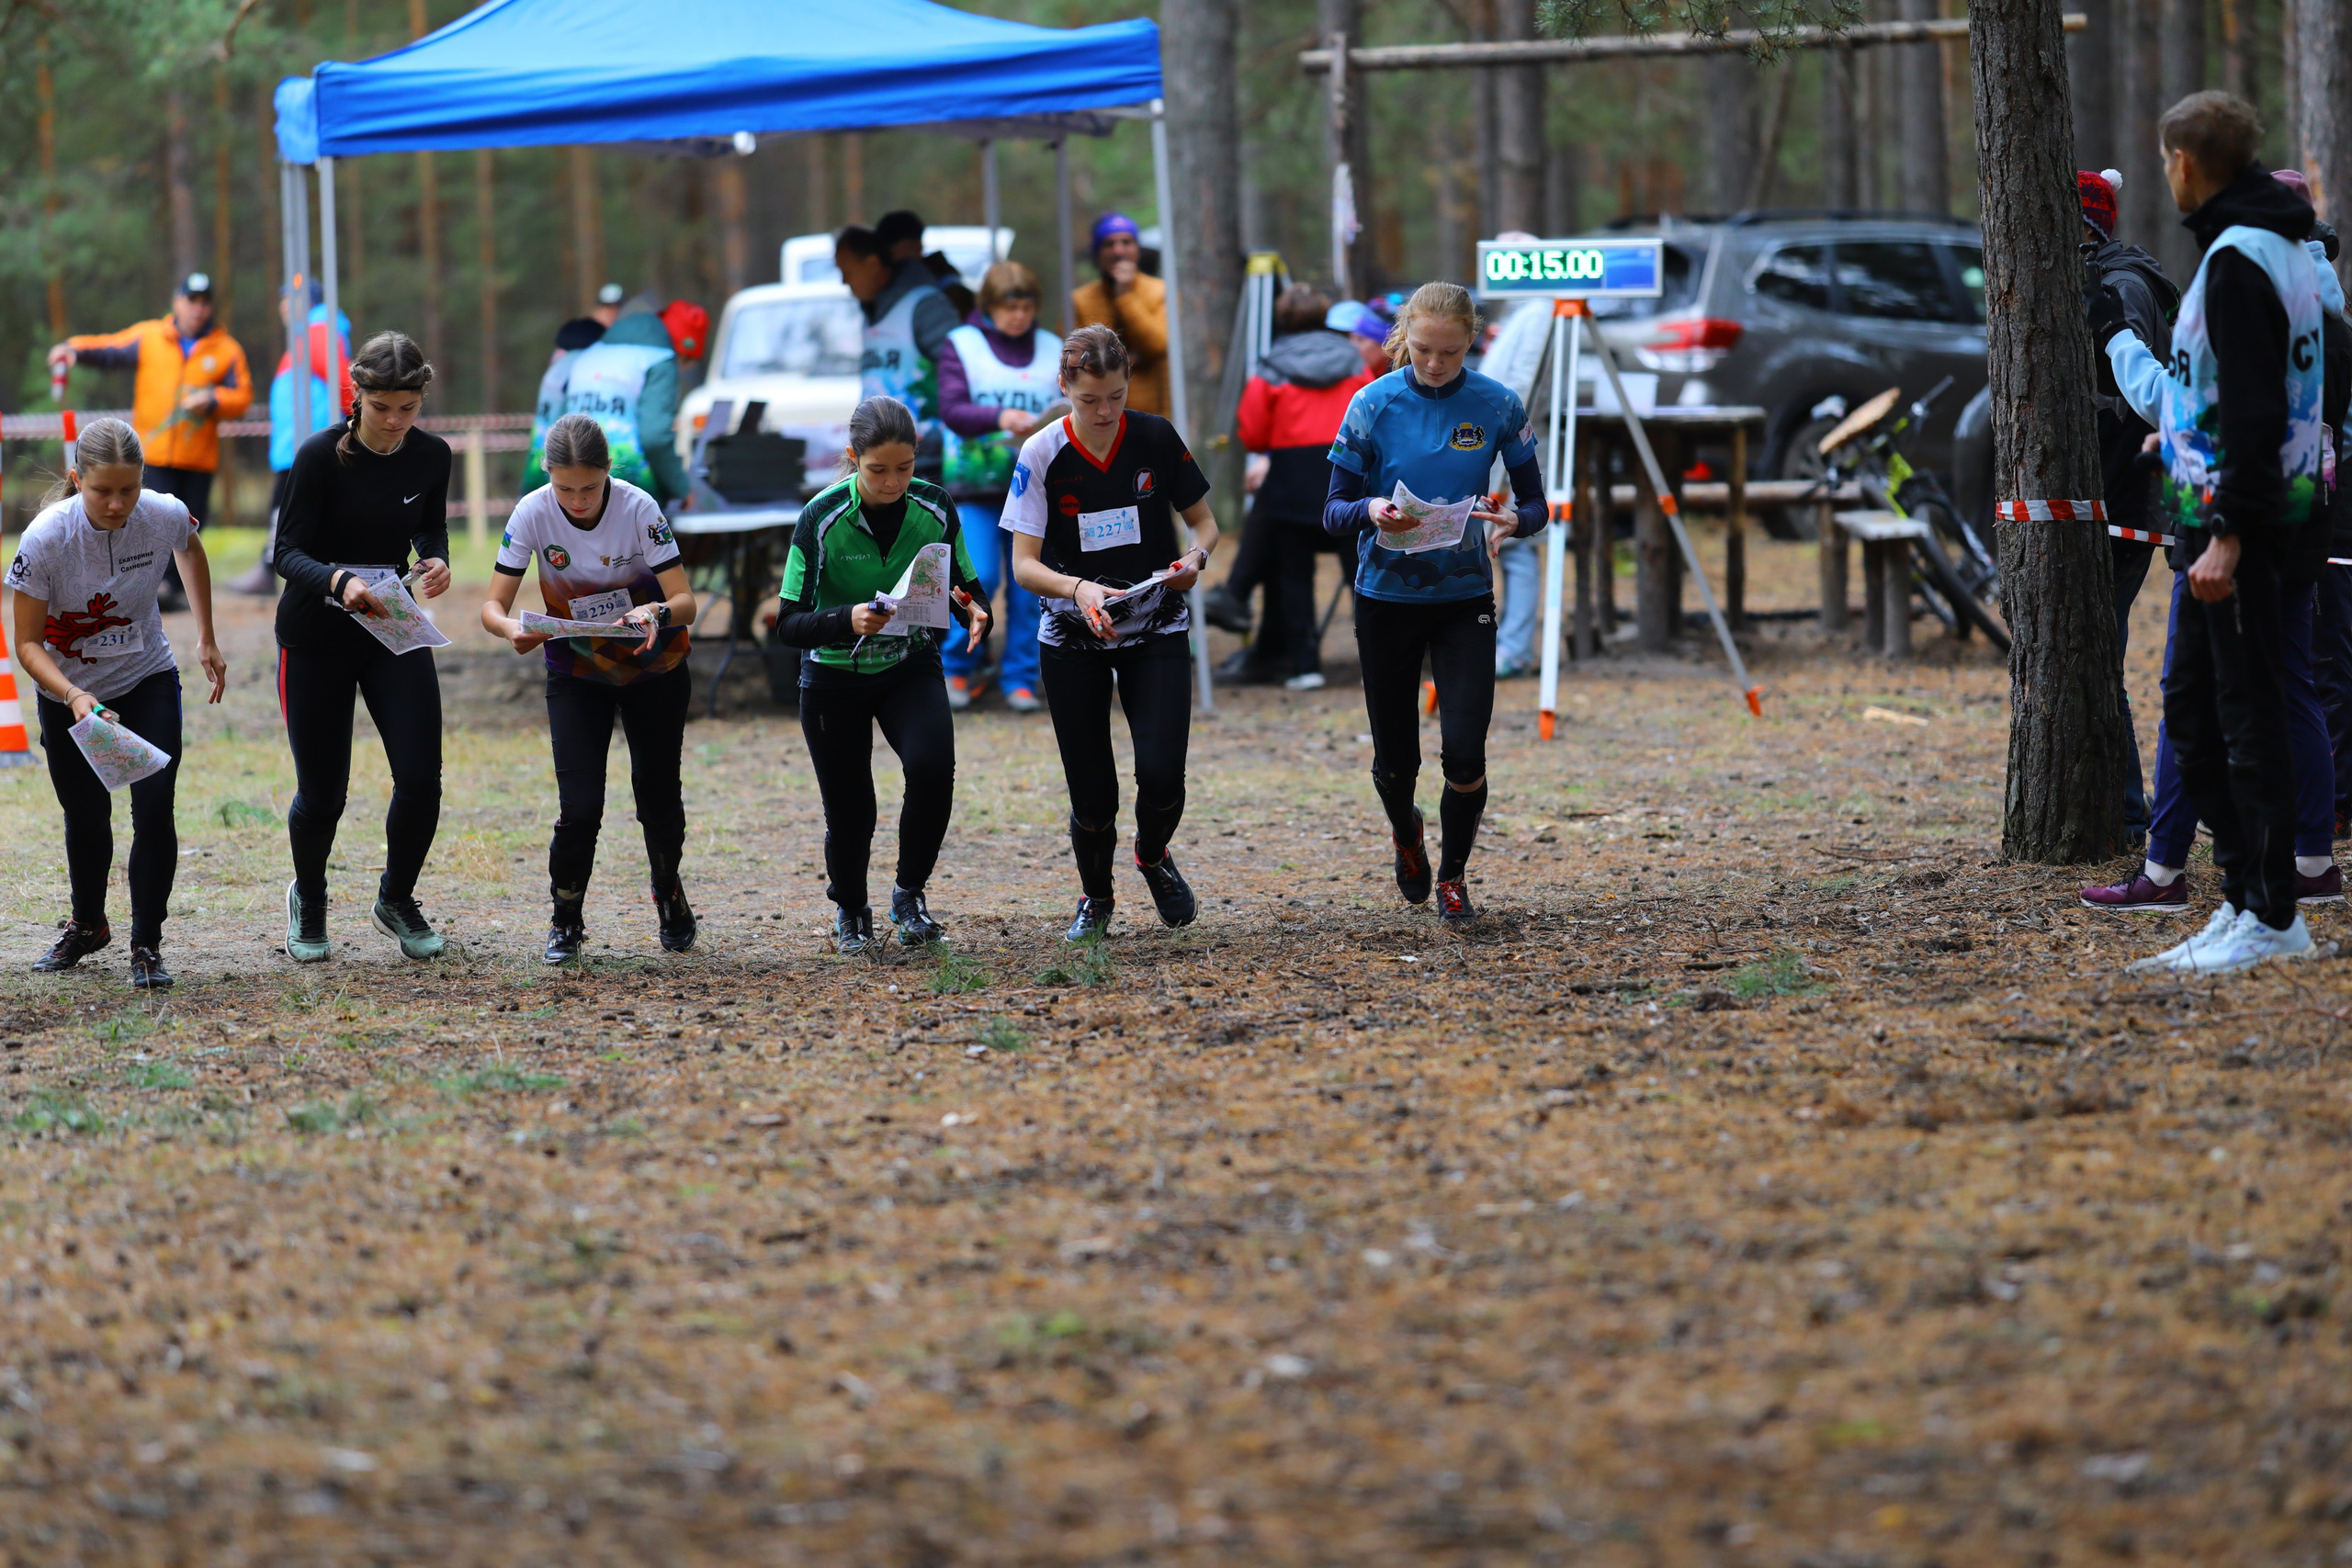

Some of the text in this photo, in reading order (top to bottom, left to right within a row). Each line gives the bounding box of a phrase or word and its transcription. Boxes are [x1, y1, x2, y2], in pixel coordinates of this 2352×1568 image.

[1486, 249, 1604, 280] 00:15.00
[1096, 522, 1122, 538] 227
[119, 550, 154, 565] Екатерина
[120, 559, 153, 572] Сахненко
[589, 602, 615, 618] 229
[100, 634, 124, 647] 231
